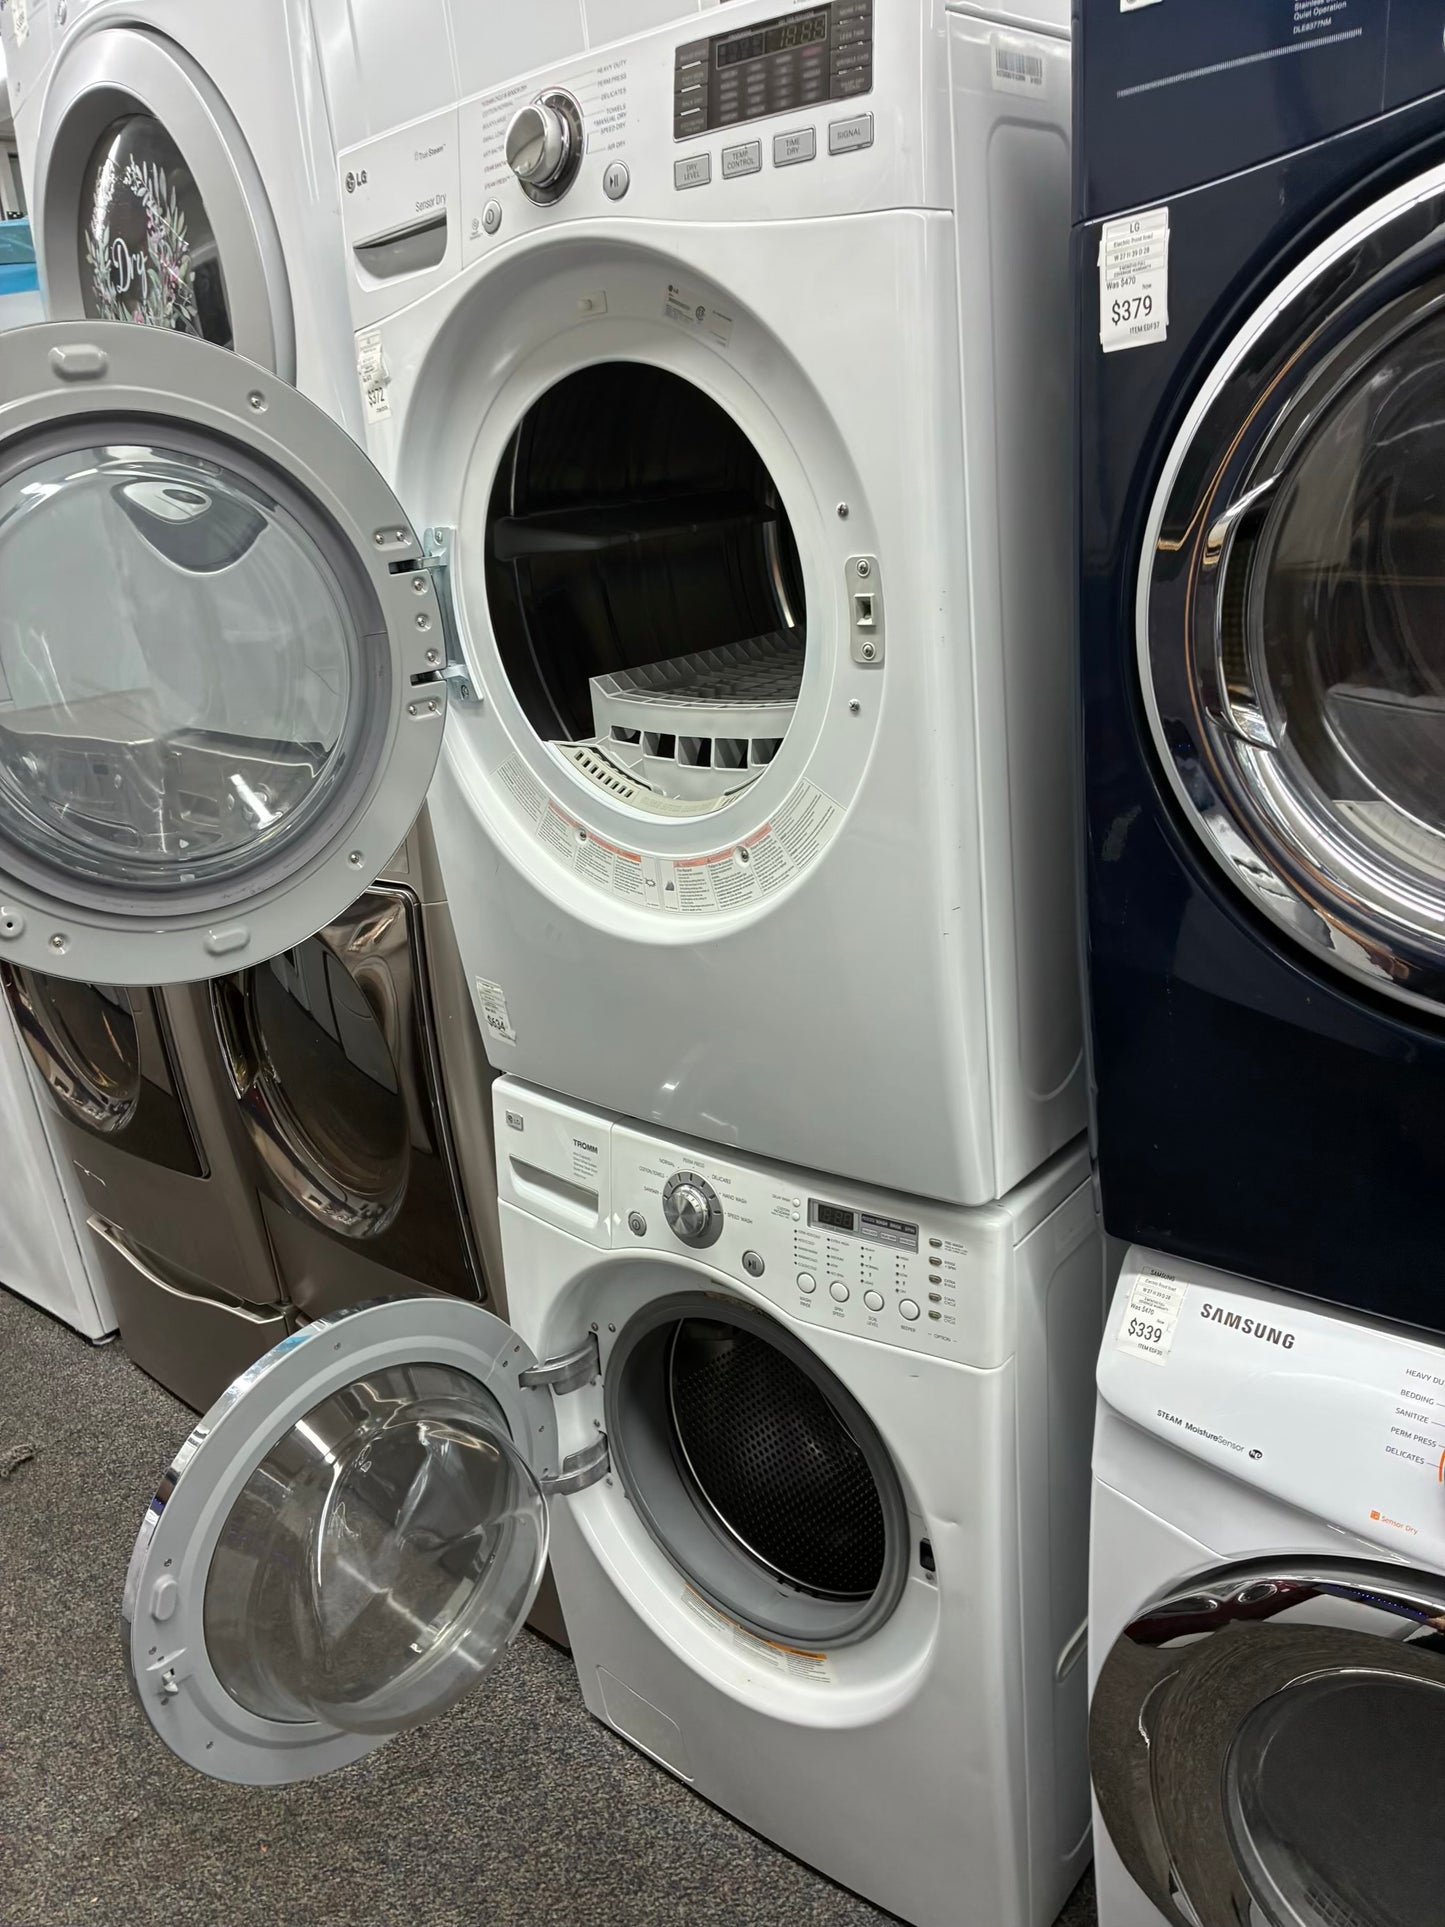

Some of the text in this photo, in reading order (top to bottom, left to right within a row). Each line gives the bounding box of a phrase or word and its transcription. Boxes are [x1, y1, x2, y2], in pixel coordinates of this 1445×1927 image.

[1293, 1, 1347, 21] Quiet Operation
[597, 59, 627, 74] HEAVY DUTY
[598, 72, 627, 88] PERM PRESS
[601, 86, 627, 101] DELICATES
[606, 103, 626, 114] TOWELS
[616, 111, 627, 120] DRY
[601, 121, 626, 135] SPEED DRY
[837, 127, 862, 140] SIGNAL
[607, 140, 626, 151] AIR DRY
[785, 137, 800, 147] TIME
[786, 146, 800, 155] DRY
[686, 163, 698, 171] DRY
[726, 157, 755, 170] CONTROL
[356, 170, 368, 187] LG
[683, 171, 701, 181] LEVEL
[415, 193, 447, 213] Sensor Dry
[1129, 221, 1141, 234] LG
[1113, 254, 1119, 262] W
[1120, 252, 1126, 261] 27
[1132, 249, 1138, 258] 39
[1138, 248, 1143, 256] D
[1144, 246, 1150, 255] 28
[110, 237, 148, 306] Dry
[1106, 275, 1137, 291] Was $470
[1111, 294, 1153, 326] $379
[1129, 325, 1143, 335] ITEM
[573, 1138, 599, 1155] TROMM
[659, 1158, 676, 1168] NORMAL
[711, 1174, 732, 1185] DELICATES
[722, 1193, 748, 1205] HAND WASH
[727, 1212, 753, 1225] SPEED WASH
[1150, 1269, 1176, 1282] SAMSUNG
[832, 1310, 846, 1319] SPEED
[1130, 1303, 1155, 1316] Was $470
[866, 1320, 879, 1328] LEVEL
[867, 1315, 878, 1323] SOIL
[900, 1324, 916, 1333] BEEPER
[1128, 1317, 1163, 1343] $339
[1200, 1302, 1296, 1351] SAMSUNG
[933, 1333, 952, 1342] OPTION
[1137, 1342, 1149, 1351] ITEM
[1405, 1368, 1445, 1386] HEAVY DU
[1400, 1388, 1435, 1406] BEDDING
[1395, 1406, 1430, 1425] SANITIZE
[1157, 1409, 1245, 1453] STEAM MoistureSensor
[1390, 1426, 1438, 1449] PERM PRESS
[1385, 1445, 1426, 1466] DELICATES
[1381, 1515, 1418, 1536] Sensor Dry
